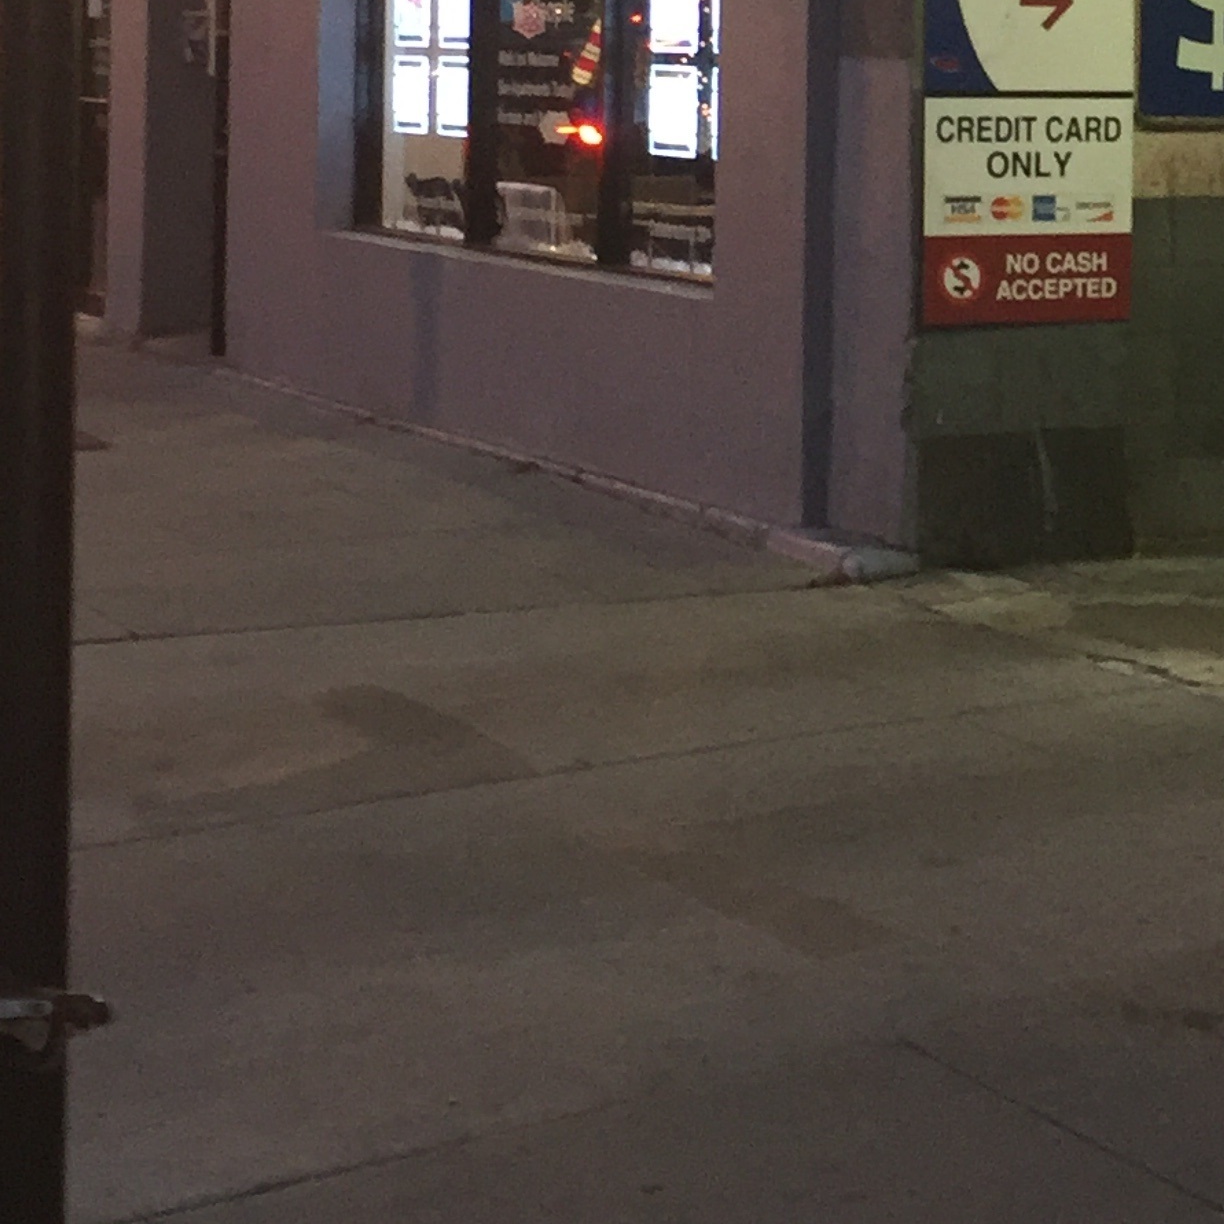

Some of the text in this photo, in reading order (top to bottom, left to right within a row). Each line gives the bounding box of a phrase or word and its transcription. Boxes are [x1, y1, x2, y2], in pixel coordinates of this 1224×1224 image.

[936, 115, 1122, 143] CREDIT CARD
[986, 151, 1072, 178] ONLY
[1005, 251, 1108, 275] NO CASH
[996, 277, 1118, 301] ACCEPTED
